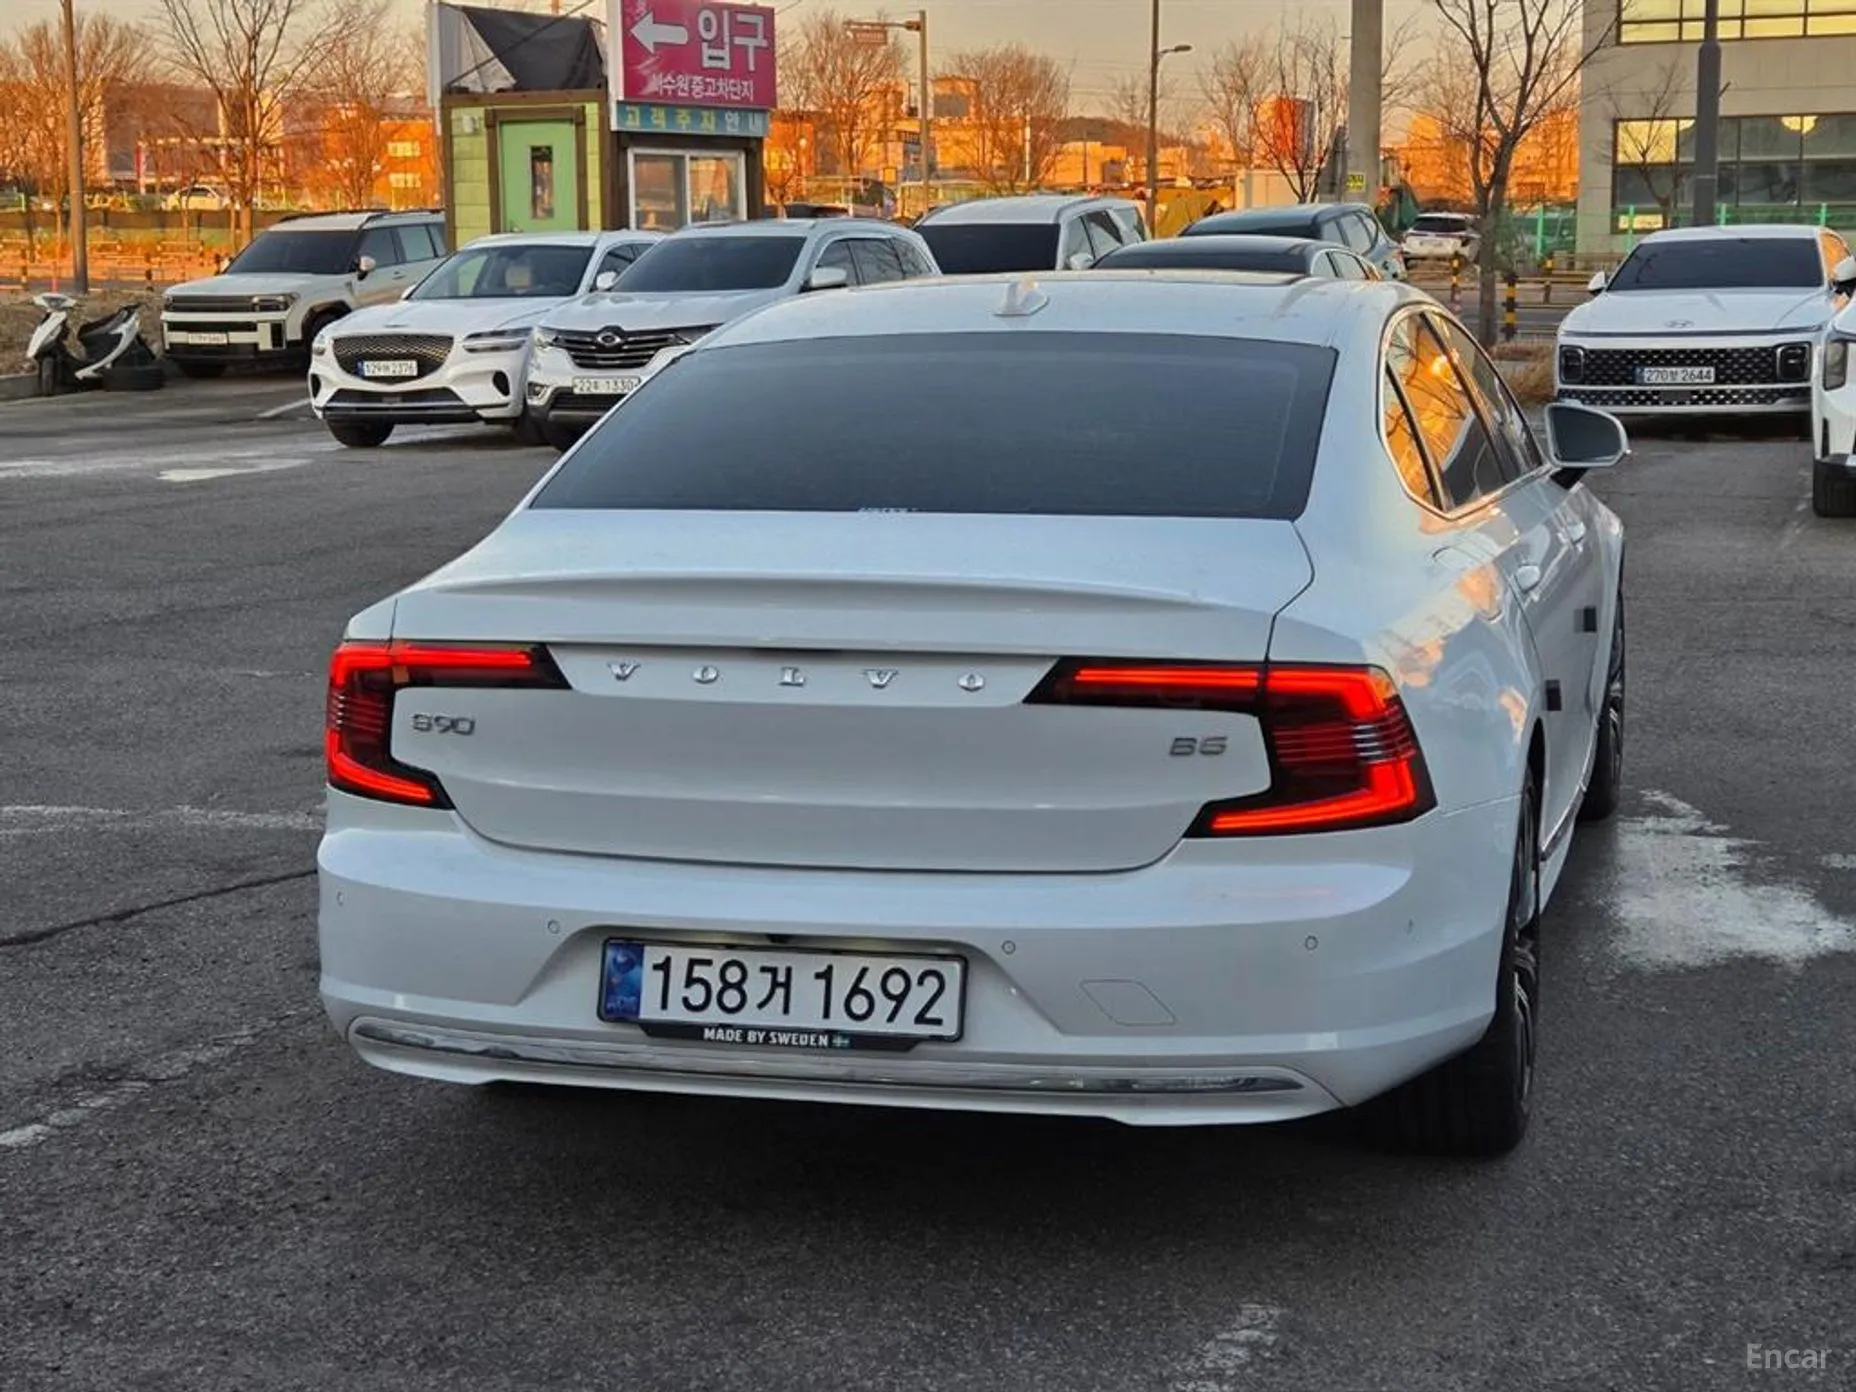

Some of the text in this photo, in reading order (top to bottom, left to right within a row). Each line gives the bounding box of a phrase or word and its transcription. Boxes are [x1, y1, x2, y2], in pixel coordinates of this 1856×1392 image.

[698, 9, 769, 72] 입구
[607, 660, 986, 693] VOLVO
[412, 713, 476, 737] S90
[1168, 736, 1229, 757] B5
[651, 954, 947, 1027] 158거 1692
[703, 1027, 829, 1047] MADE BY SWEDEN
